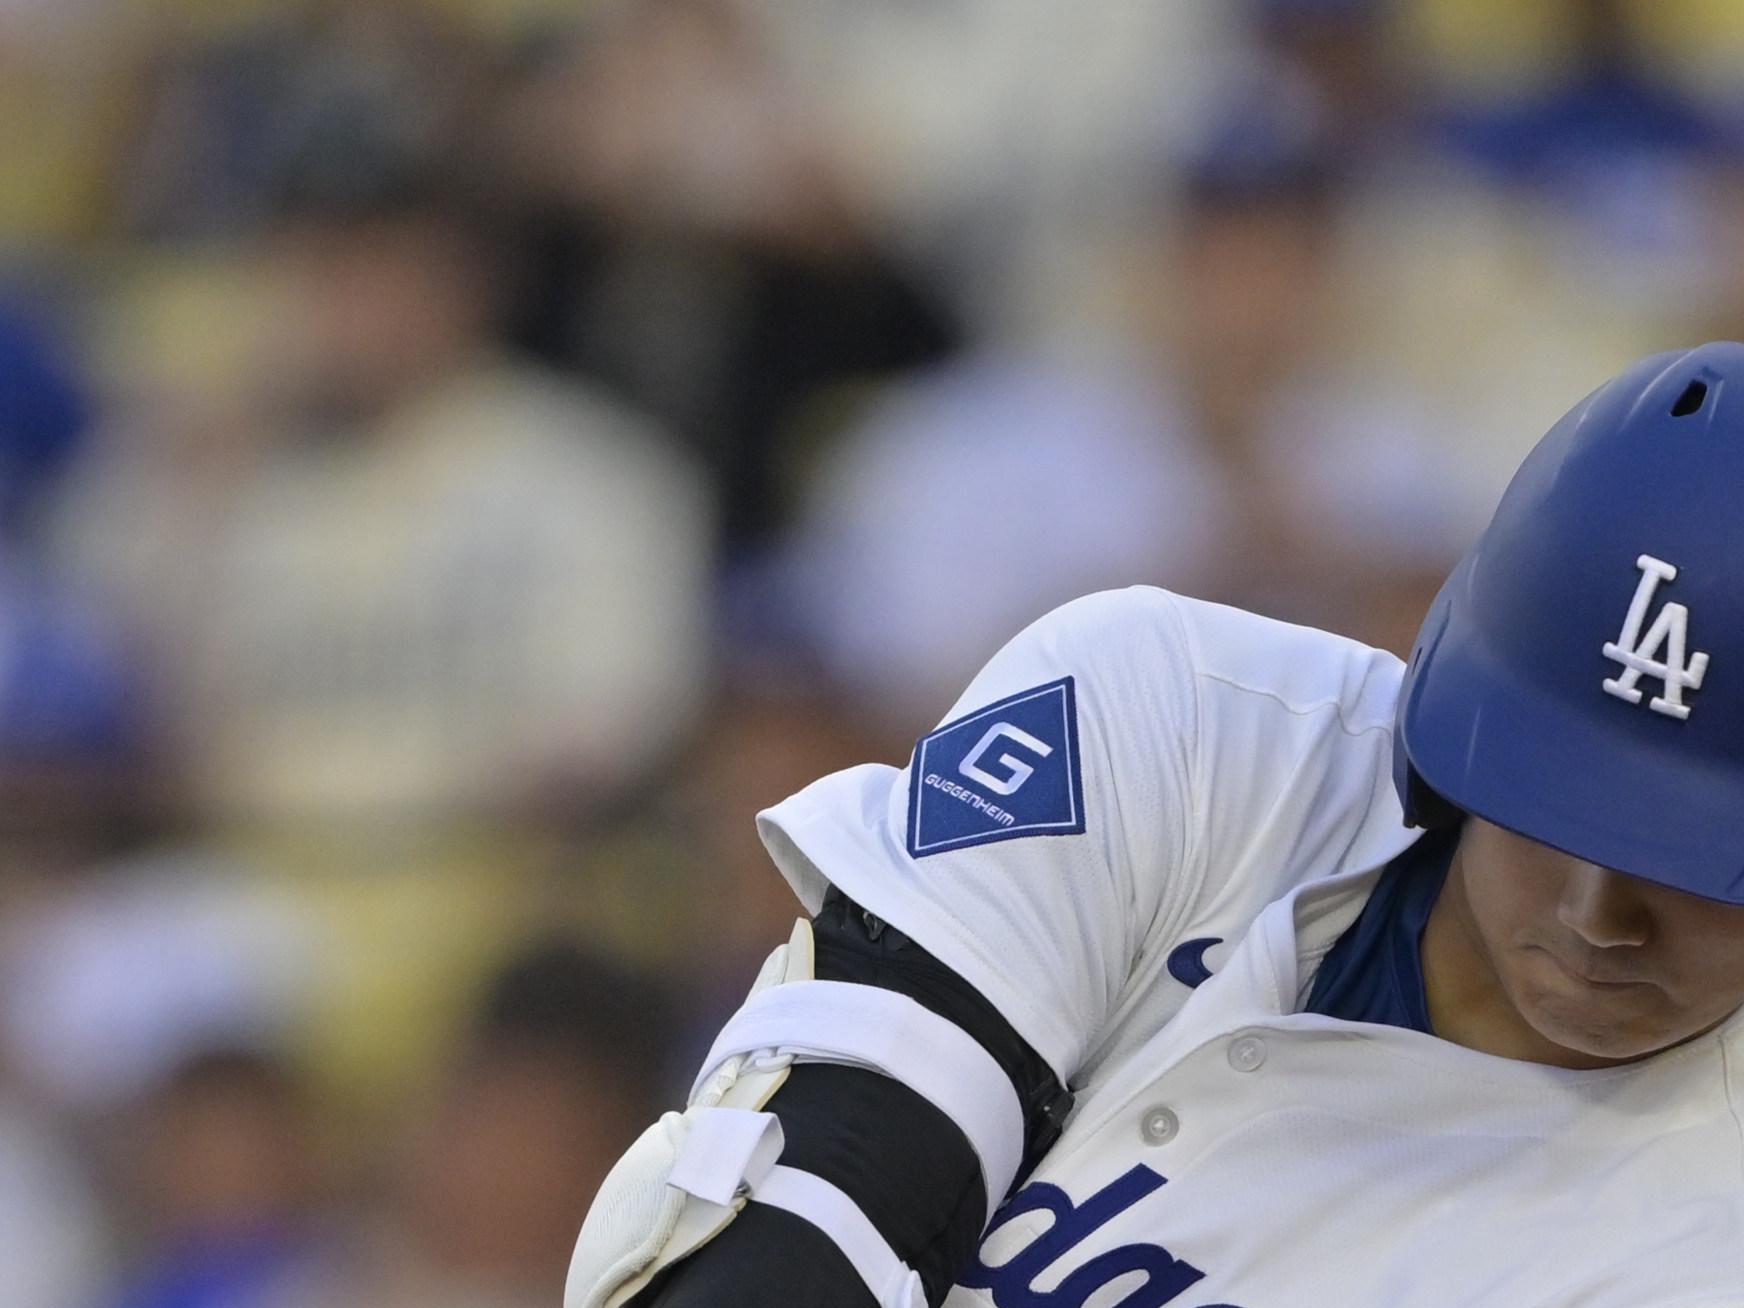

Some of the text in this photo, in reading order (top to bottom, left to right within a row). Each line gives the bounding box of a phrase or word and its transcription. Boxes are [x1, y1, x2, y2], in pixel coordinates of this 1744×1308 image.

[1602, 554, 1709, 720] LA
[958, 721, 1054, 797] G
[923, 773, 1016, 828] GUGGENHEIM
